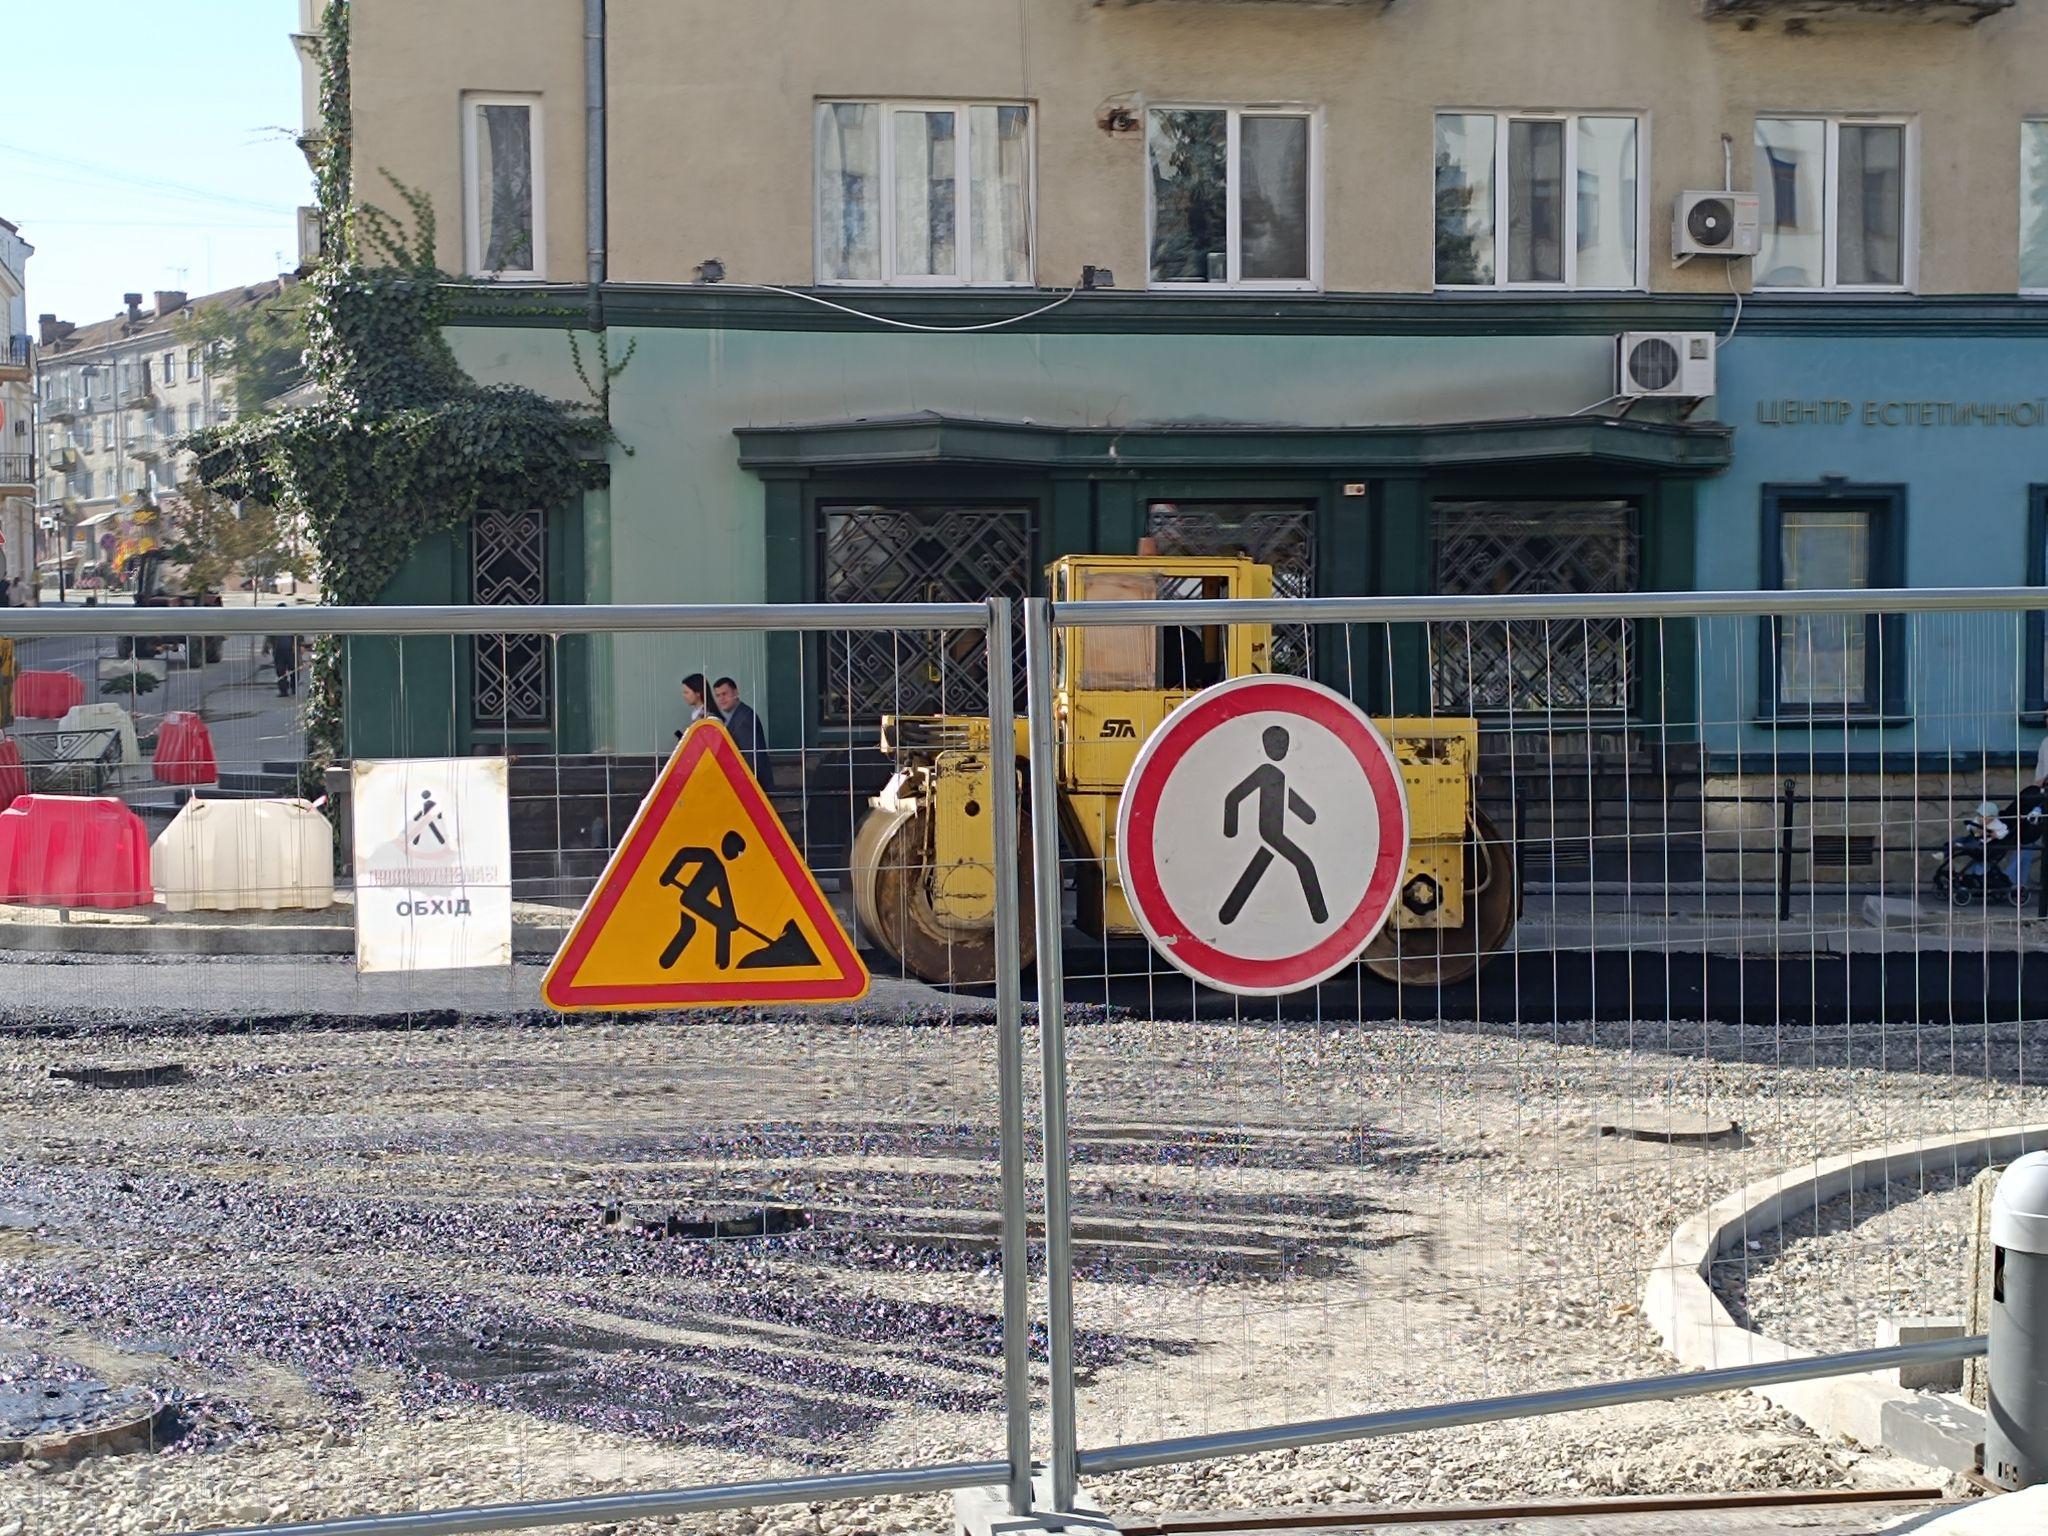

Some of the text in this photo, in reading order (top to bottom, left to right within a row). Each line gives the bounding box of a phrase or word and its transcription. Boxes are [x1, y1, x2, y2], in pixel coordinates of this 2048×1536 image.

[1757, 400, 1851, 427] ЦЕНТР
[1100, 719, 1136, 738] STA
[396, 899, 472, 917] ОБХІД
